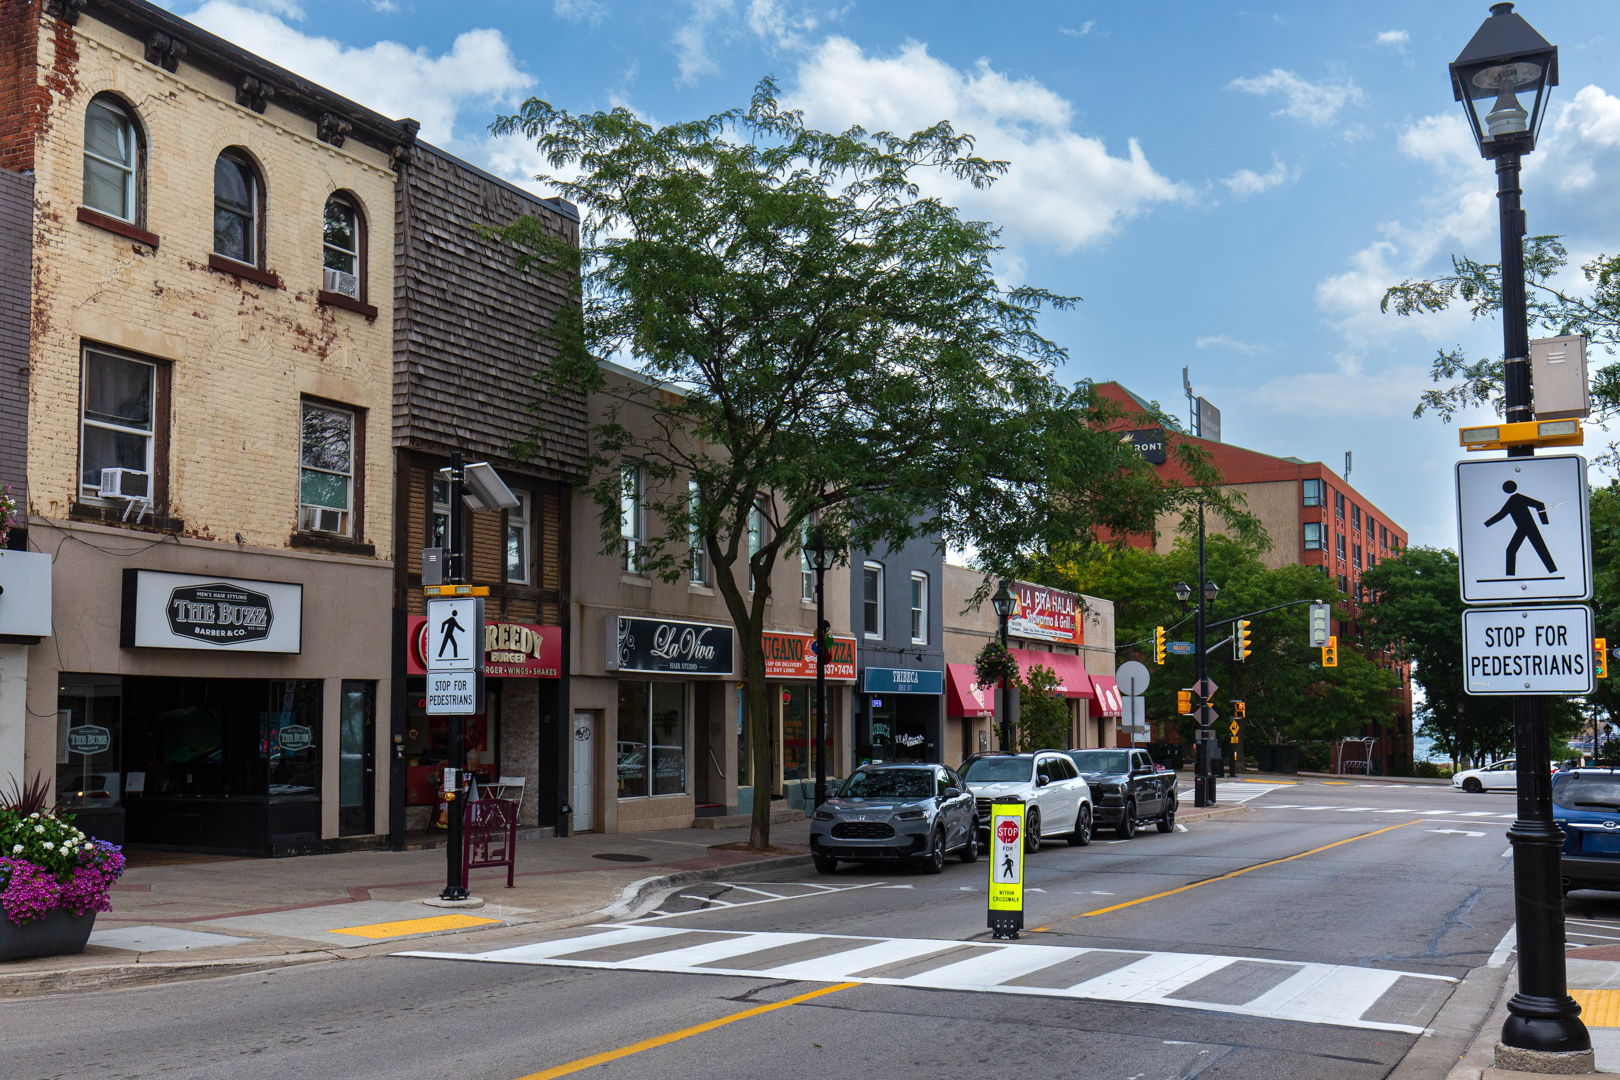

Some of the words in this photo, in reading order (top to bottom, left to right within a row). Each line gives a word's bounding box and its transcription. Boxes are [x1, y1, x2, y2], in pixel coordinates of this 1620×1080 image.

[1021, 588, 1031, 608] LA
[1034, 591, 1051, 612] PITA
[173, 598, 215, 624] THE
[217, 602, 267, 627] BUZZ
[1054, 614, 1059, 628] &
[1060, 615, 1071, 630] Grill
[484, 623, 544, 660] REEDY
[1485, 626, 1525, 648] STOP
[1535, 625, 1568, 647] FOR
[490, 651, 527, 664] BURGER
[763, 636, 804, 662] UGANO
[829, 642, 854, 664] ZZA
[507, 668, 529, 676] WINGS
[533, 668, 557, 676] SHAKES
[669, 662, 681, 670] HAIR
[681, 663, 698, 671] STUDIO
[1471, 654, 1584, 677] PEDESTRIANS
[892, 670, 919, 684] TRIBECA
[435, 680, 451, 692] STOP
[454, 680, 467, 692] FOR
[429, 694, 473, 706] PEDESTRIANS
[998, 827, 1019, 837] STOP
